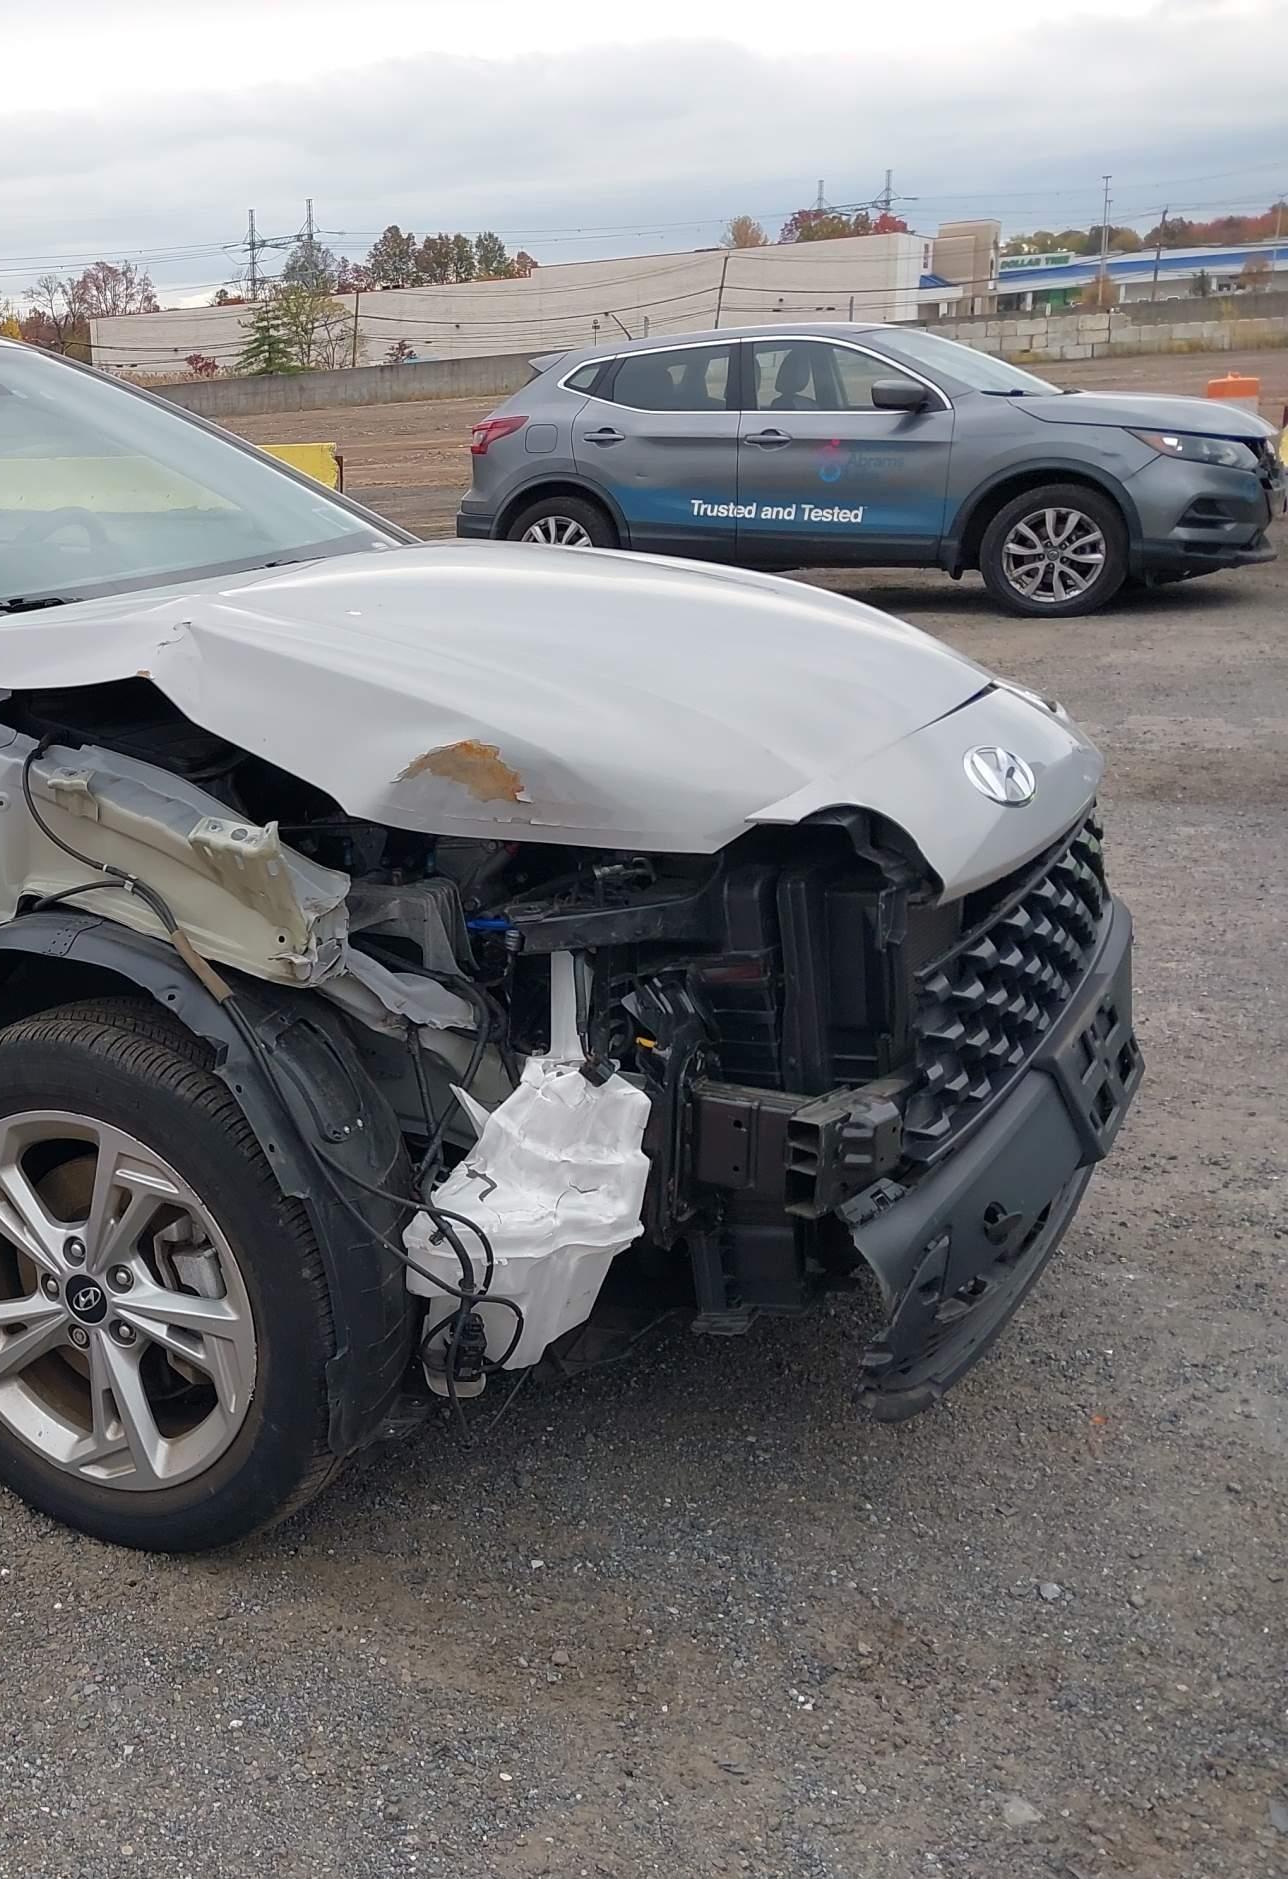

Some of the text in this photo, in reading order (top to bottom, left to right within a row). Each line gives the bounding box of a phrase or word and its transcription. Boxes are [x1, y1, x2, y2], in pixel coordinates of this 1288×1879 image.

[691, 500, 863, 523] Trusted and Tested
